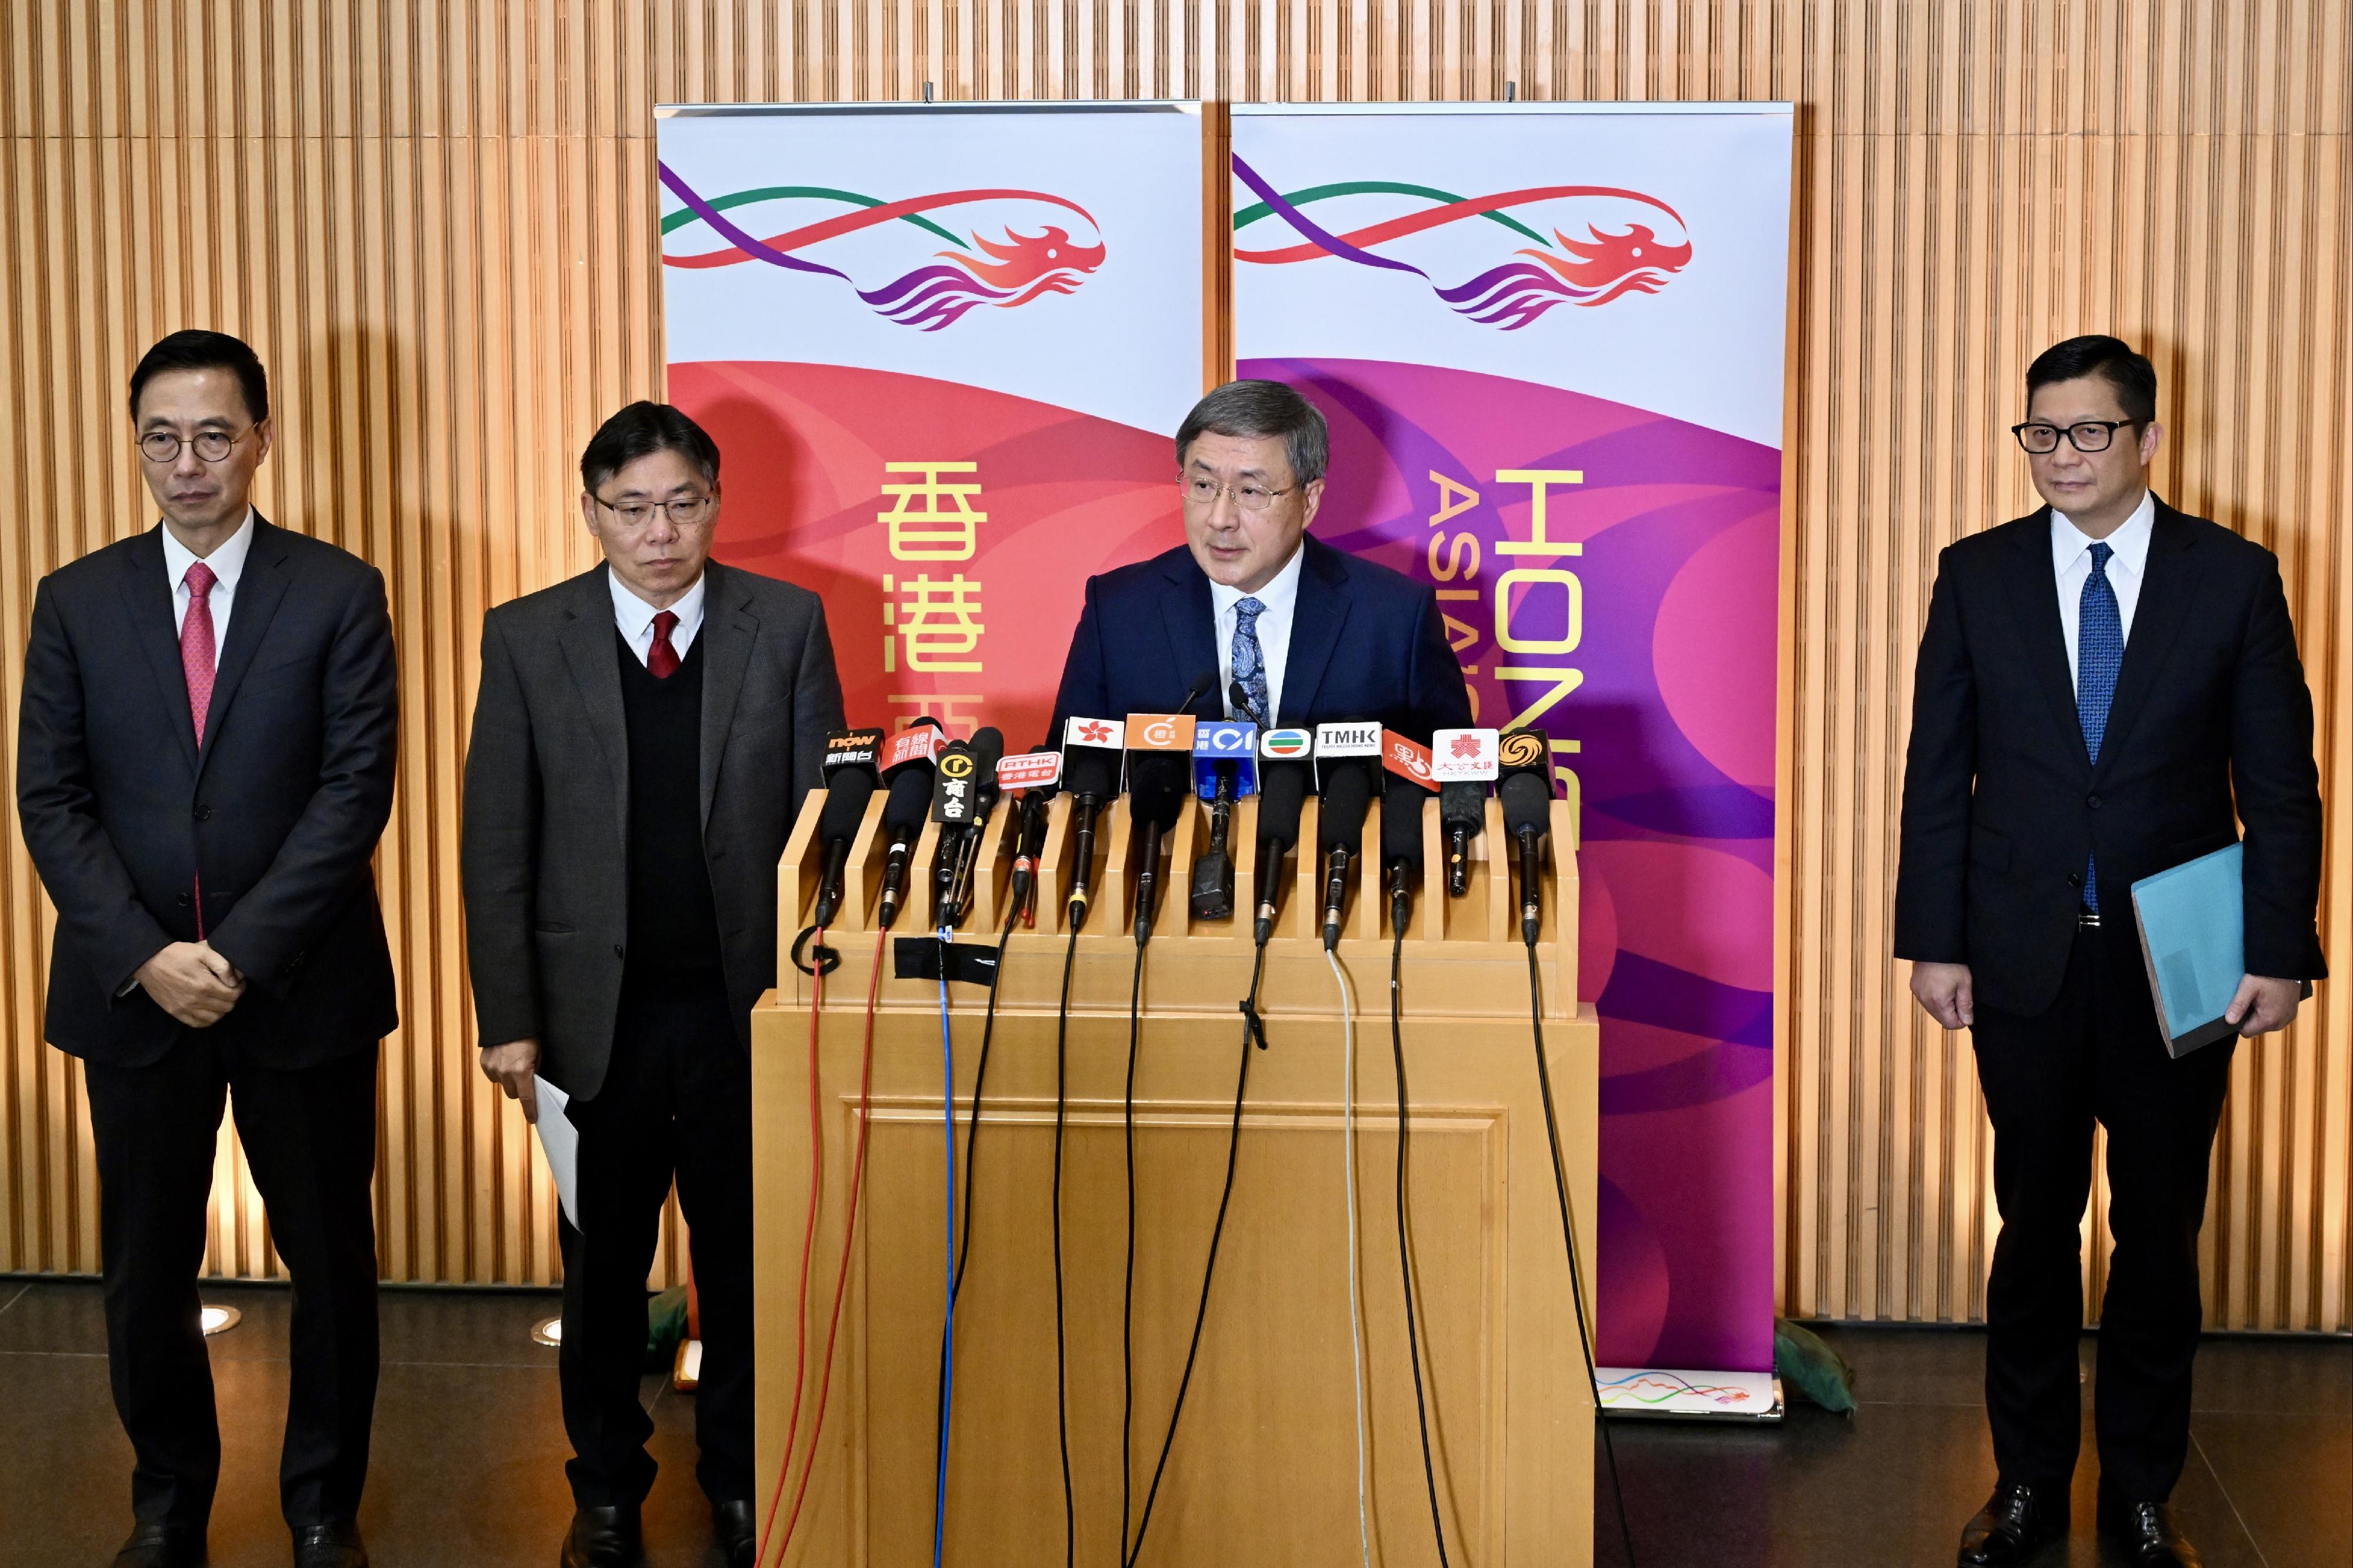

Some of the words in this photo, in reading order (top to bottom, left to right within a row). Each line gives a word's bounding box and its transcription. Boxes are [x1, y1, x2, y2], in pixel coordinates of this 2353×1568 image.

[829, 733, 875, 750] now
[895, 732, 929, 750] 有線
[1197, 729, 1210, 750] 香港
[1322, 730, 1375, 744] TMHK
[825, 750, 873, 764] 新聞台
[892, 744, 928, 763] 新聞
[1005, 757, 1054, 768] RTHK
[1438, 761, 1494, 770] 大公文匯
[1001, 769, 1053, 780] 香港電台
[942, 778, 968, 818] 商台
